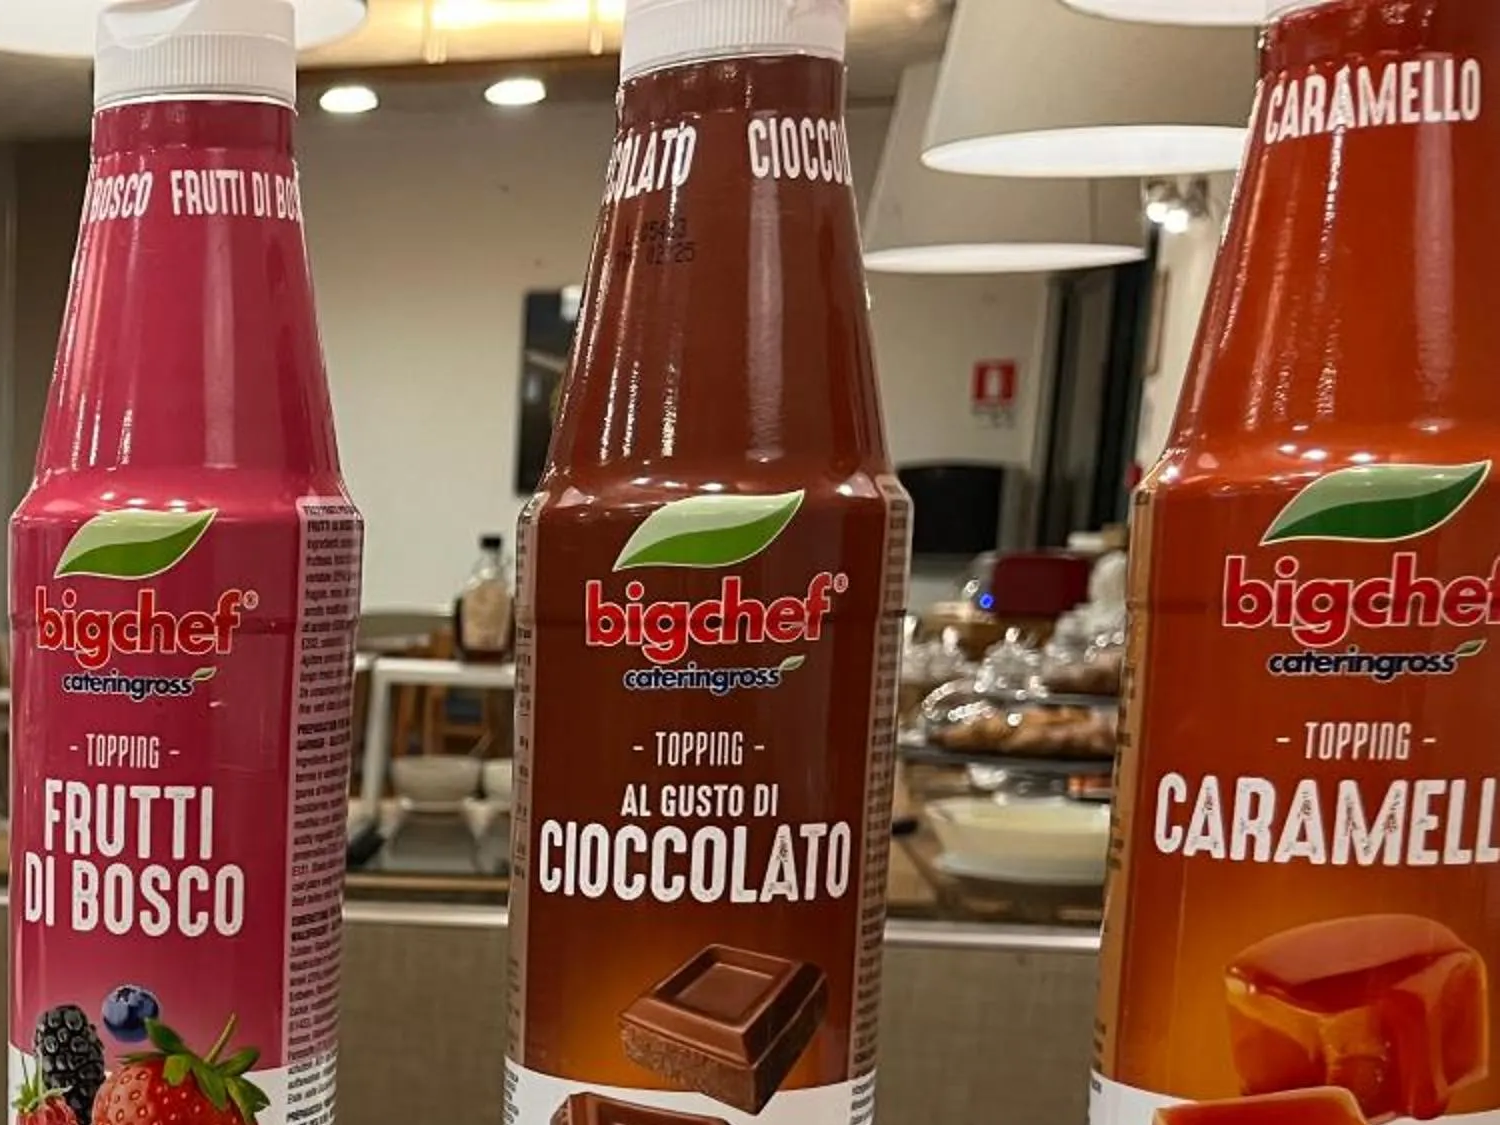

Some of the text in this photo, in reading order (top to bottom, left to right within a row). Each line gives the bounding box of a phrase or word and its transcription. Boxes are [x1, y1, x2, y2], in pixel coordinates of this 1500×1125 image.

[1265, 57, 1482, 145] CARAMELLO
[89, 170, 154, 220] BOSCO
[170, 169, 247, 216] FRUTTI
[252, 172, 271, 217] DI
[624, 662, 781, 696] cateringross
[1267, 645, 1456, 682] cateringross
[62, 669, 195, 701] cateringross
[86, 733, 160, 769] TOPPING
[655, 731, 744, 766] TOPPING
[1303, 721, 1413, 760] TOPPING
[44, 778, 214, 860] FRUTTI
[621, 783, 779, 817] AL GUSTO DI
[1155, 771, 1500, 866] CARAMELL
[539, 820, 852, 903] CIOCCOLATO
[24, 851, 245, 937] DI BOSCO
